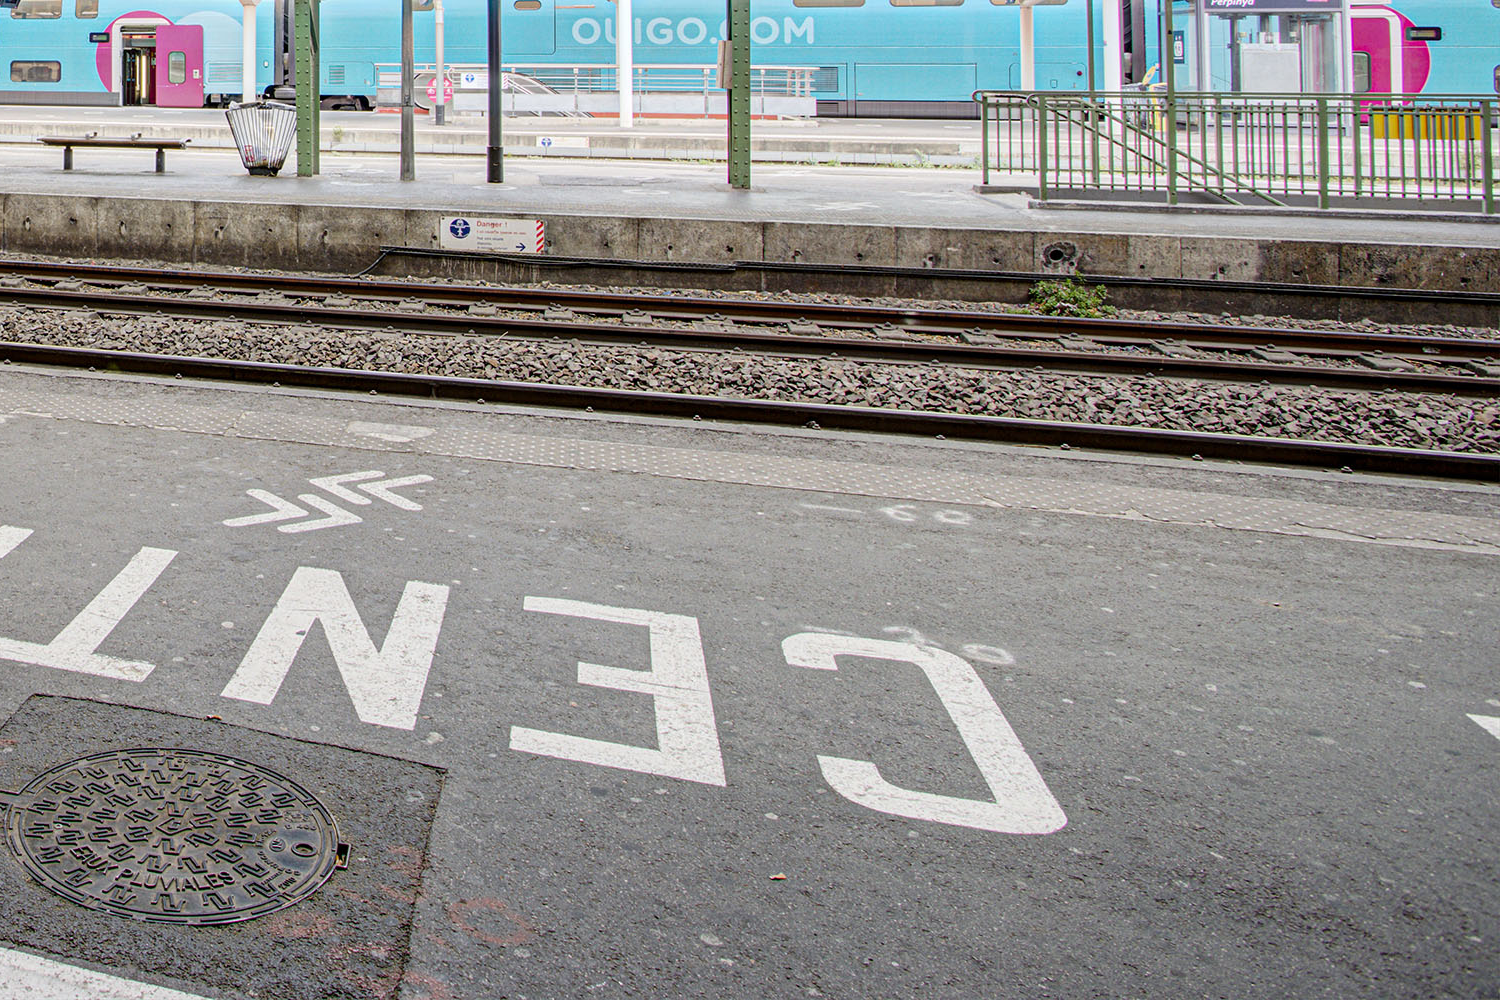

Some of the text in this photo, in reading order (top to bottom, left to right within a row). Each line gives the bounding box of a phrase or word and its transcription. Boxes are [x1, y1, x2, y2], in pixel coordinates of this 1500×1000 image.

[571, 16, 816, 45] OUIGO.OM
[476, 220, 503, 229] Danger
[69, 846, 119, 875] EAUX
[115, 868, 236, 892] PLUVIALES
